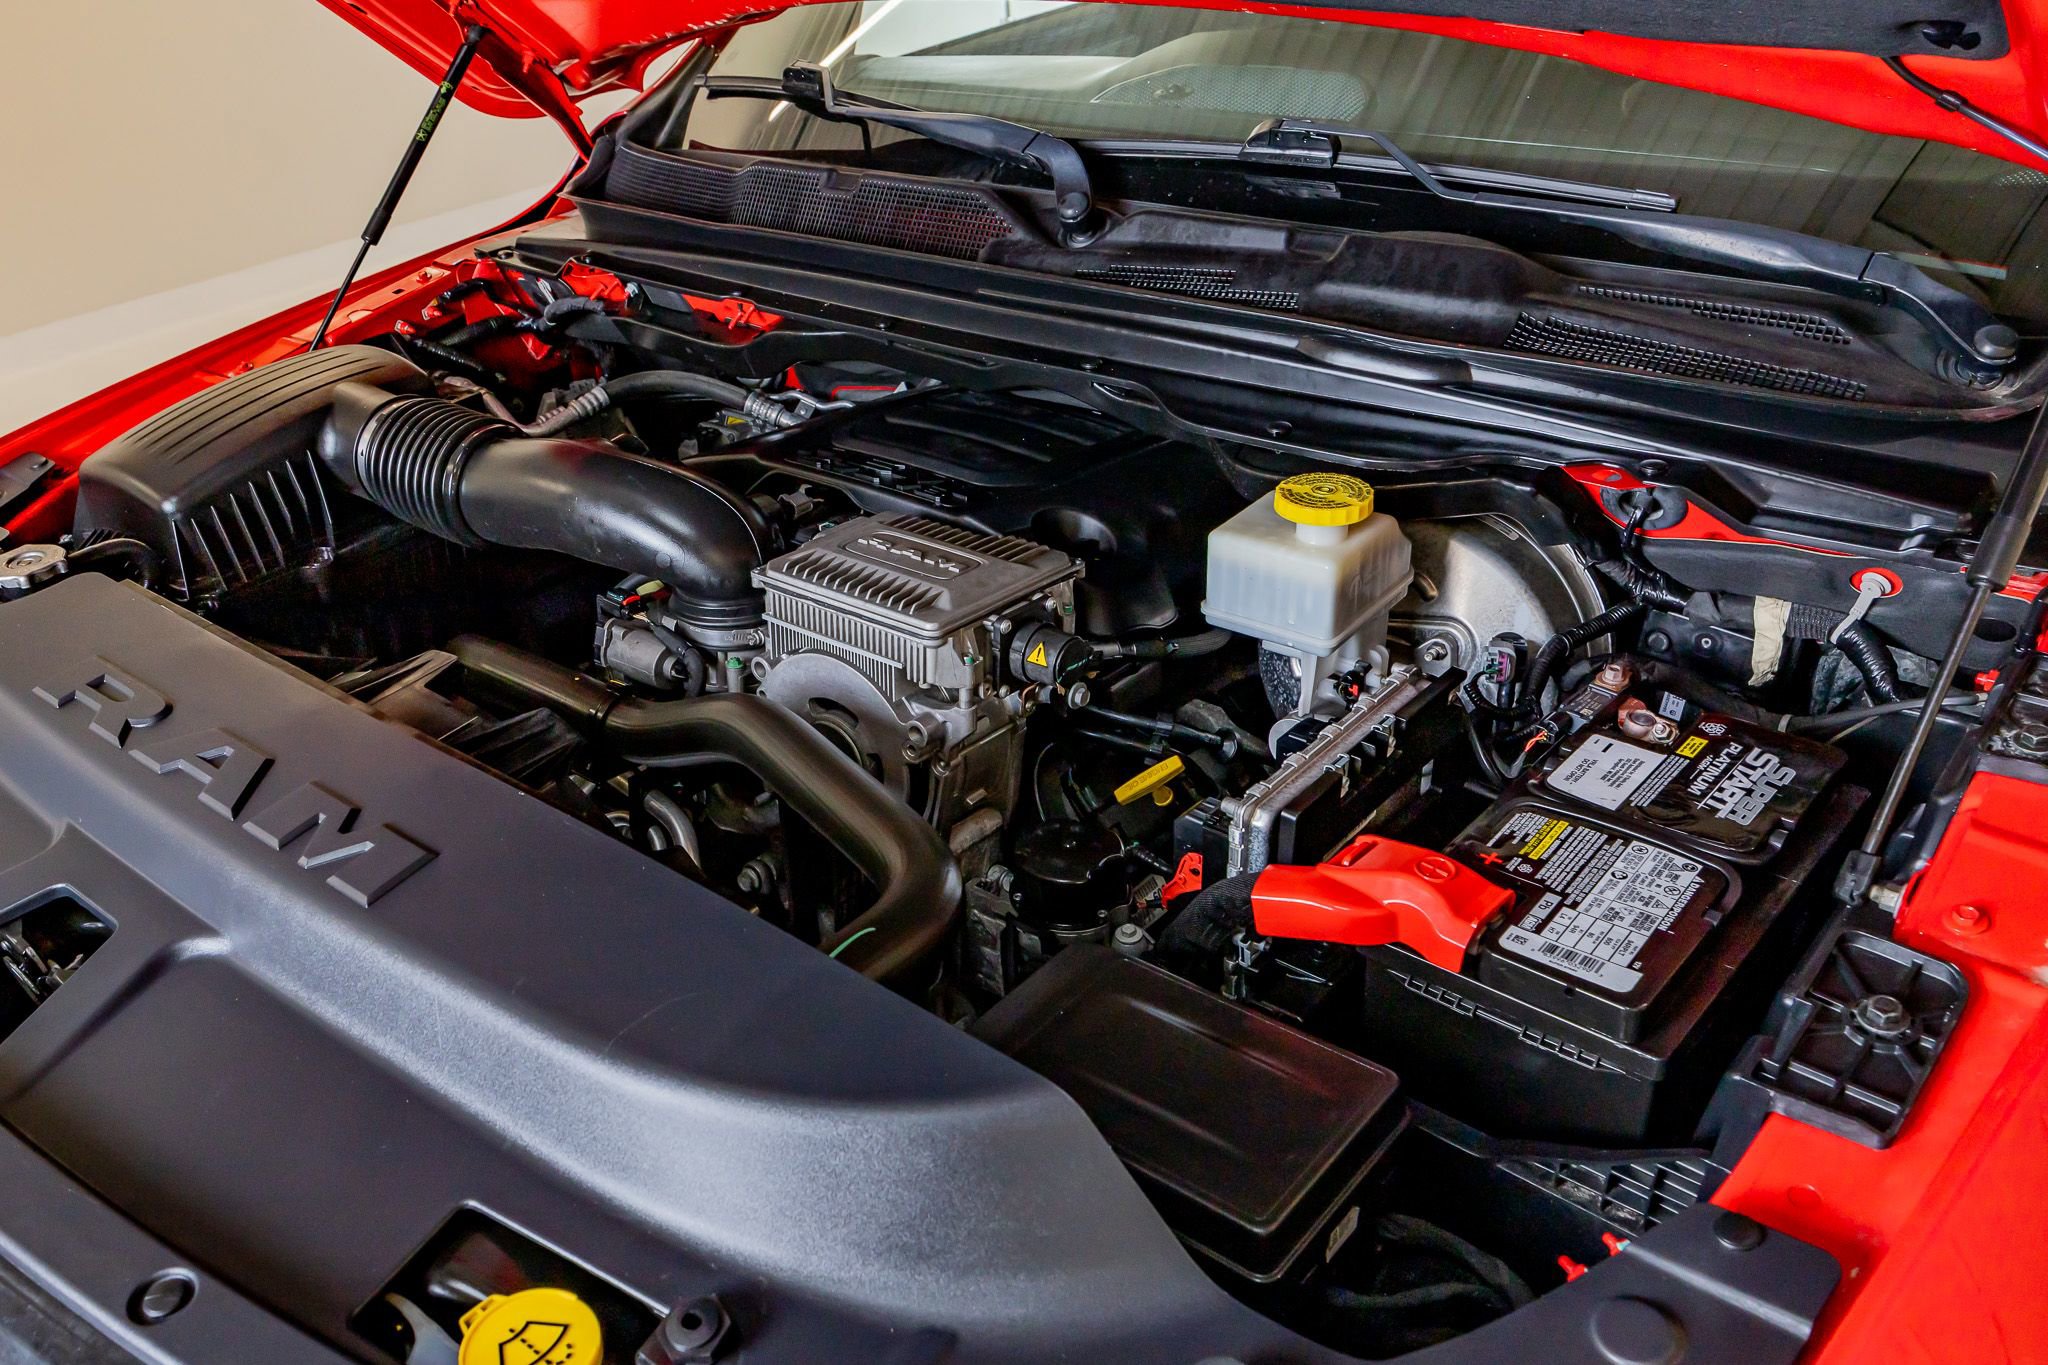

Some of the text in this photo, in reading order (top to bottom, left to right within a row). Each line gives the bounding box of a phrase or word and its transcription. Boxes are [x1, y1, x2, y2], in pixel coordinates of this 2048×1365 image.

[857, 537, 960, 573] RAM
[31, 656, 439, 908] RAM
[1571, 767, 1589, 782] BATTERY
[1573, 763, 1584, 771] NOT
[1686, 741, 1743, 795] PLATINUM
[1708, 748, 1779, 819] START
[1723, 761, 1798, 826] SUPER
[1537, 899, 1553, 911] Pb
[1656, 881, 1700, 931] DANGER/POISON
